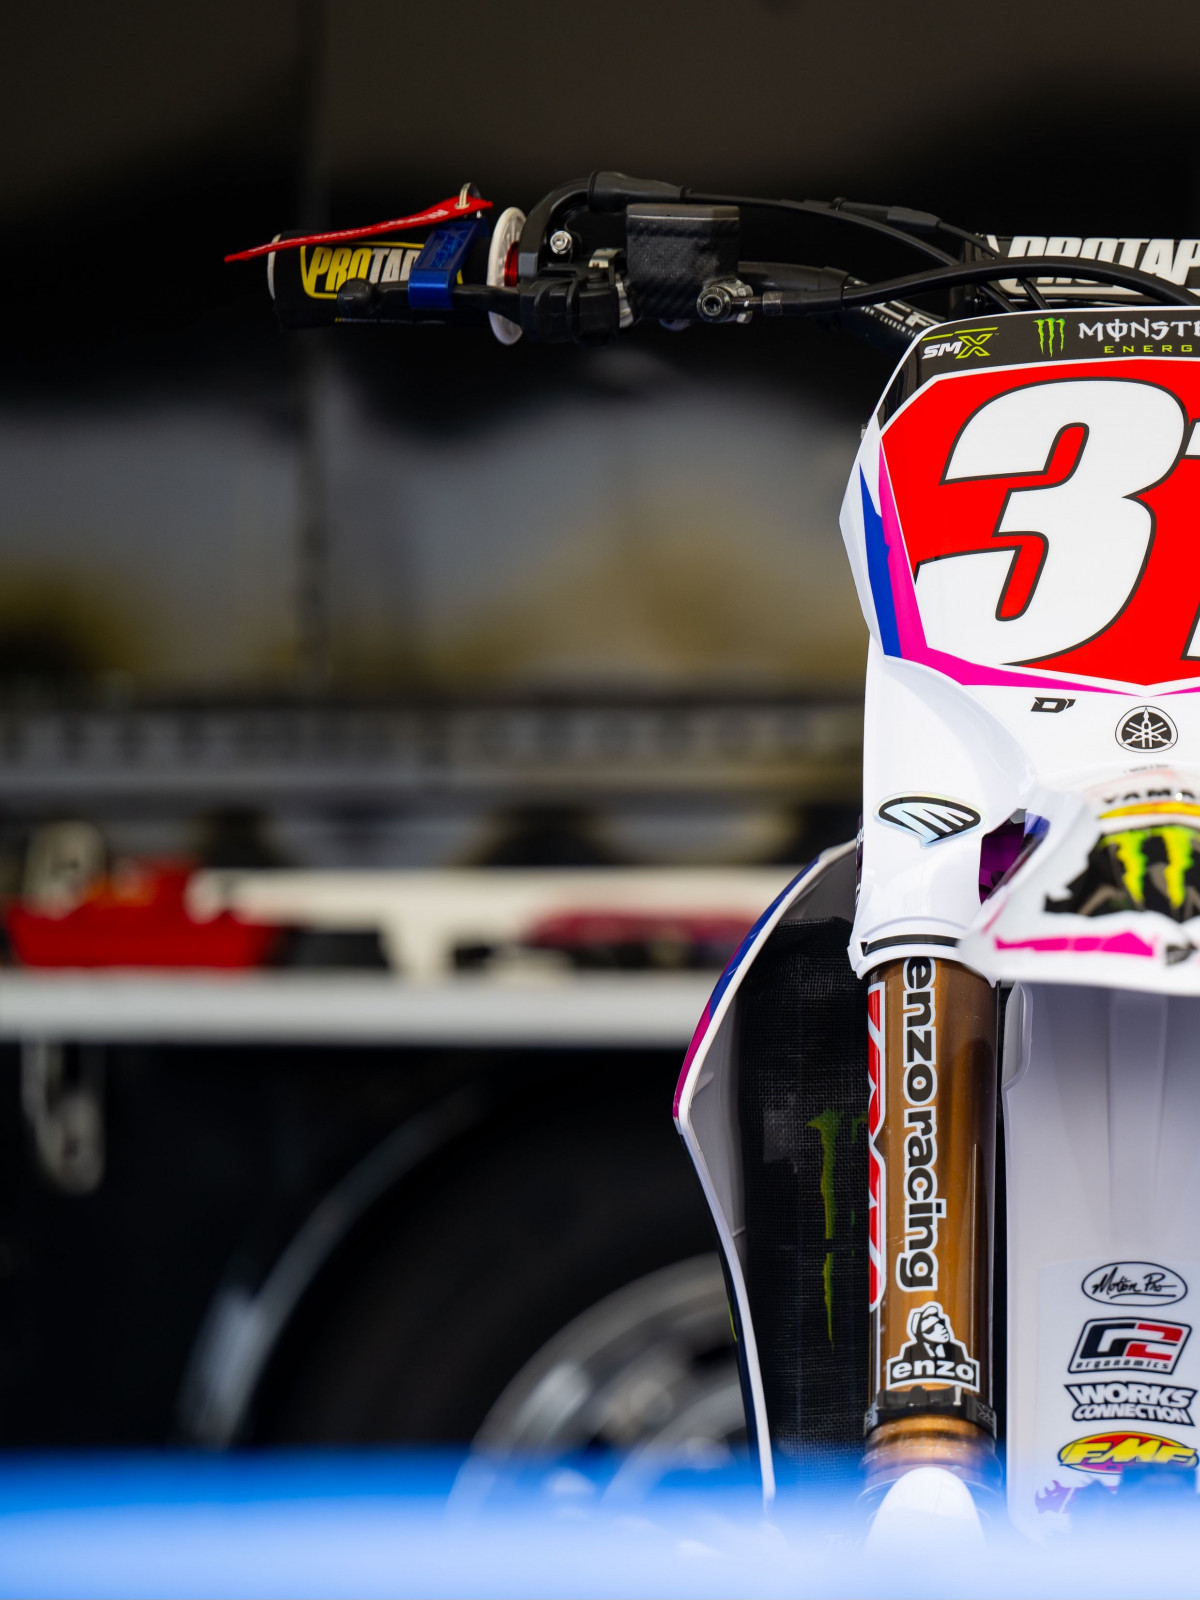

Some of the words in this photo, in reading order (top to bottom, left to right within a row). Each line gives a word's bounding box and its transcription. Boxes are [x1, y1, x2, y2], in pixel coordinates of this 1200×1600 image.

[311, 246, 422, 292] PROTAP
[922, 332, 993, 359] SMX
[1092, 1266, 1142, 1295] Motion
[1143, 1272, 1177, 1292] Pro
[1080, 1322, 1183, 1361] G2
[892, 1360, 974, 1380] enzo
[1076, 1359, 1169, 1370] ergonomics
[1068, 1382, 1196, 1406] WORKS
[1073, 1404, 1194, 1425] CONNECTION
[1061, 1437, 1197, 1465] FMF
